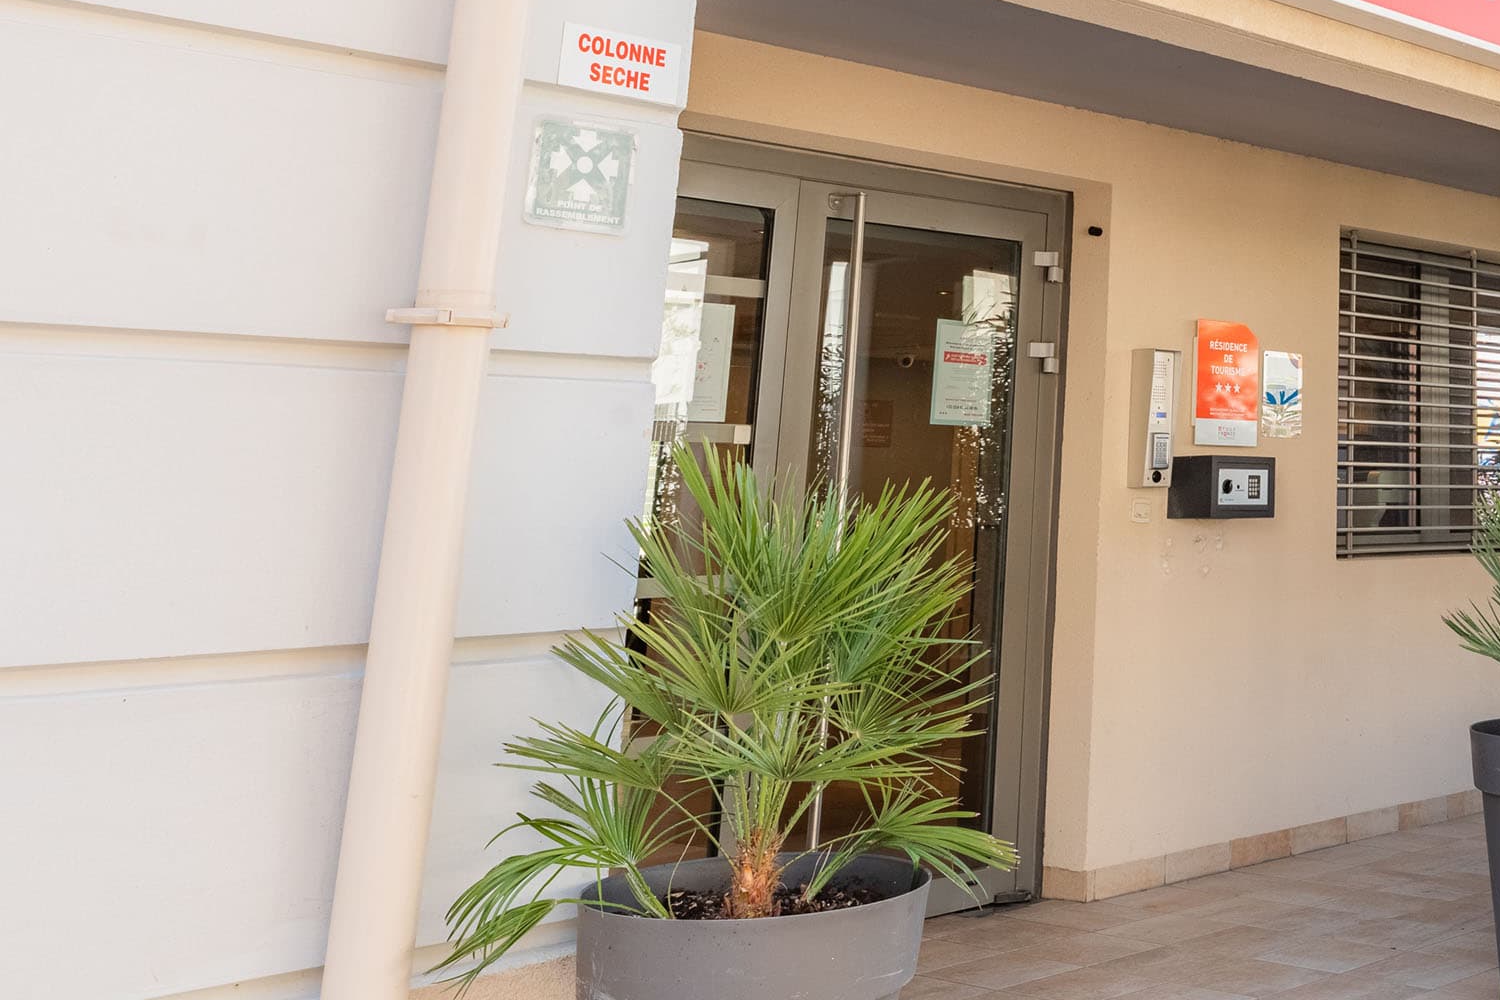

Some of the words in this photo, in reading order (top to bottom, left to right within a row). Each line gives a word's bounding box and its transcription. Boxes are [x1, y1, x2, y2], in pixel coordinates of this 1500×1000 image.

[578, 33, 666, 67] COLONNE
[589, 62, 650, 91] SECHE
[1209, 339, 1248, 353] RÉSIDENCE
[1224, 354, 1233, 363] DE
